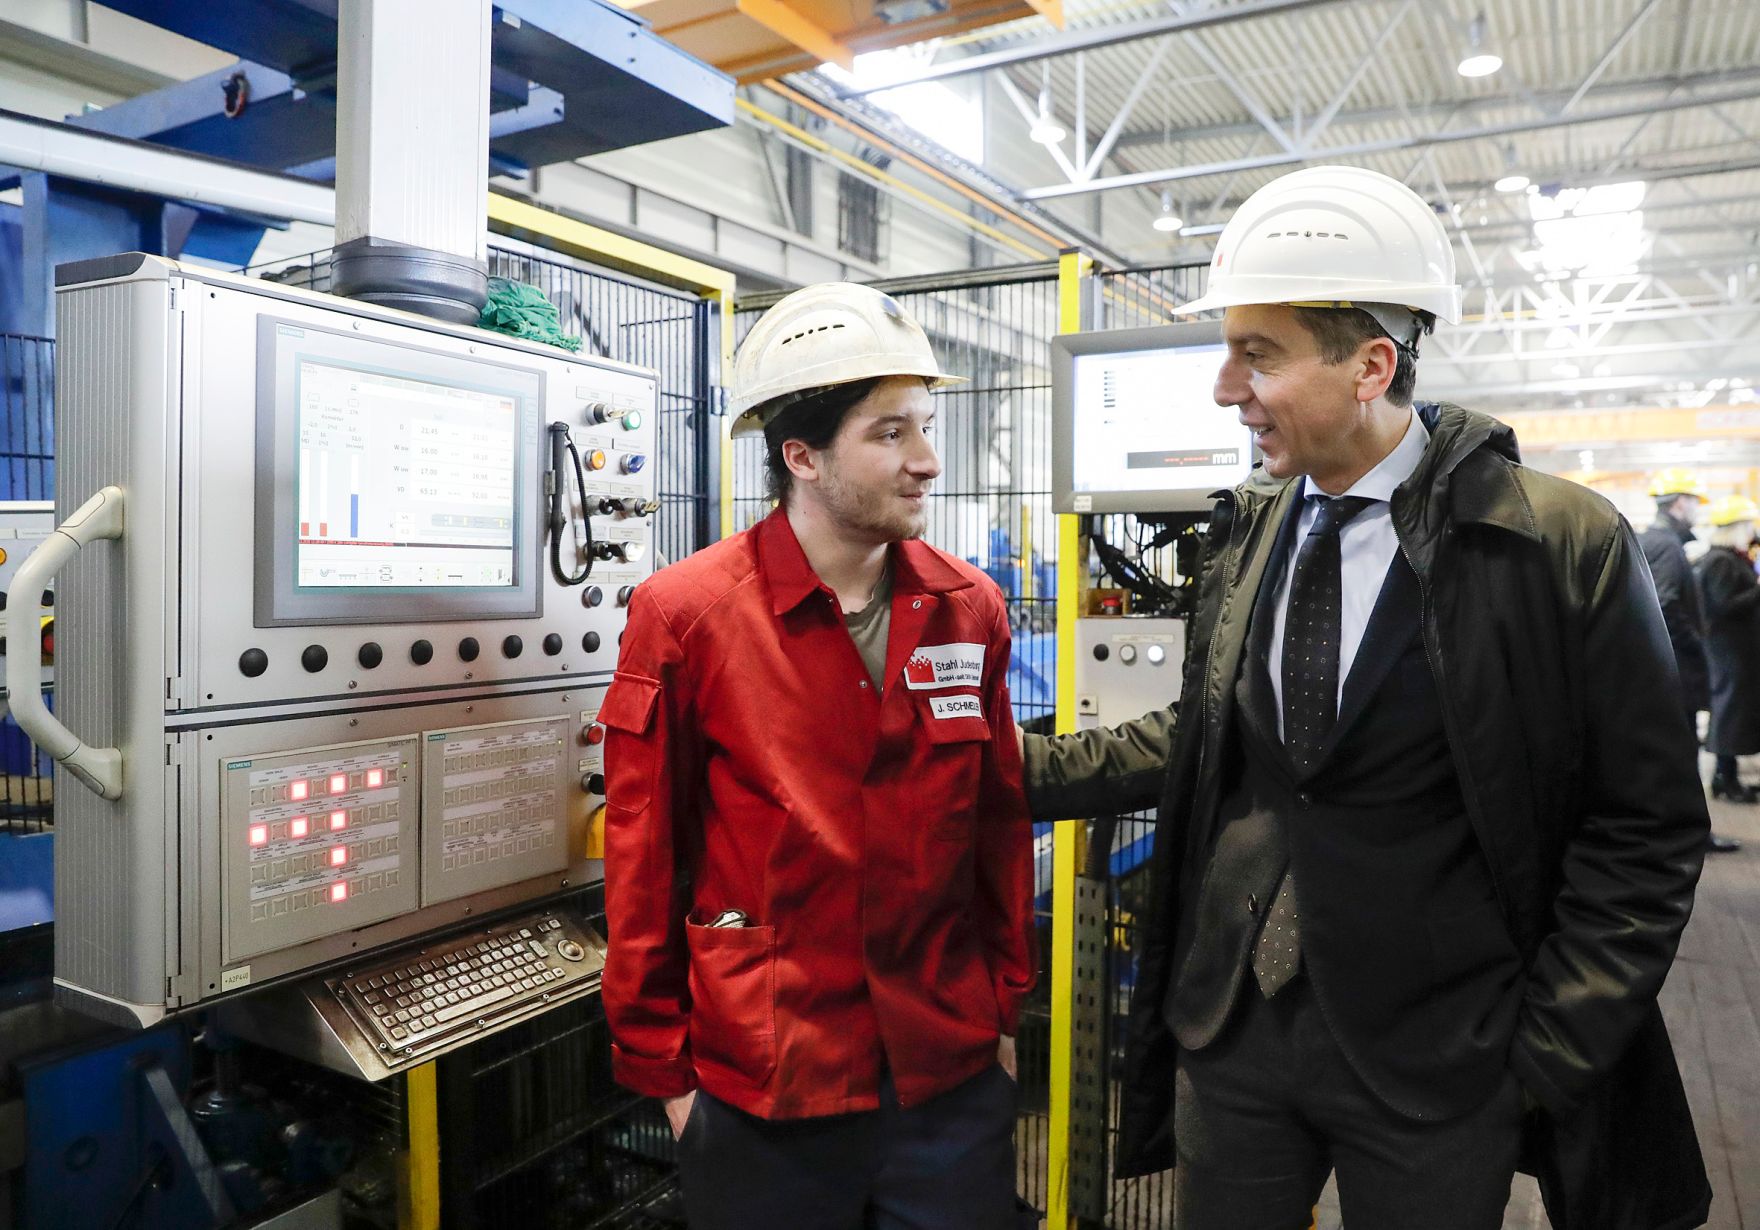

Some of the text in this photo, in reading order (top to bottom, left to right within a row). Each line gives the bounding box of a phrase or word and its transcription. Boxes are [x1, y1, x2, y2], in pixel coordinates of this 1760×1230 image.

[1212, 453, 1237, 464] mm
[935, 660, 958, 672] Stahl
[938, 704, 945, 713] J.
